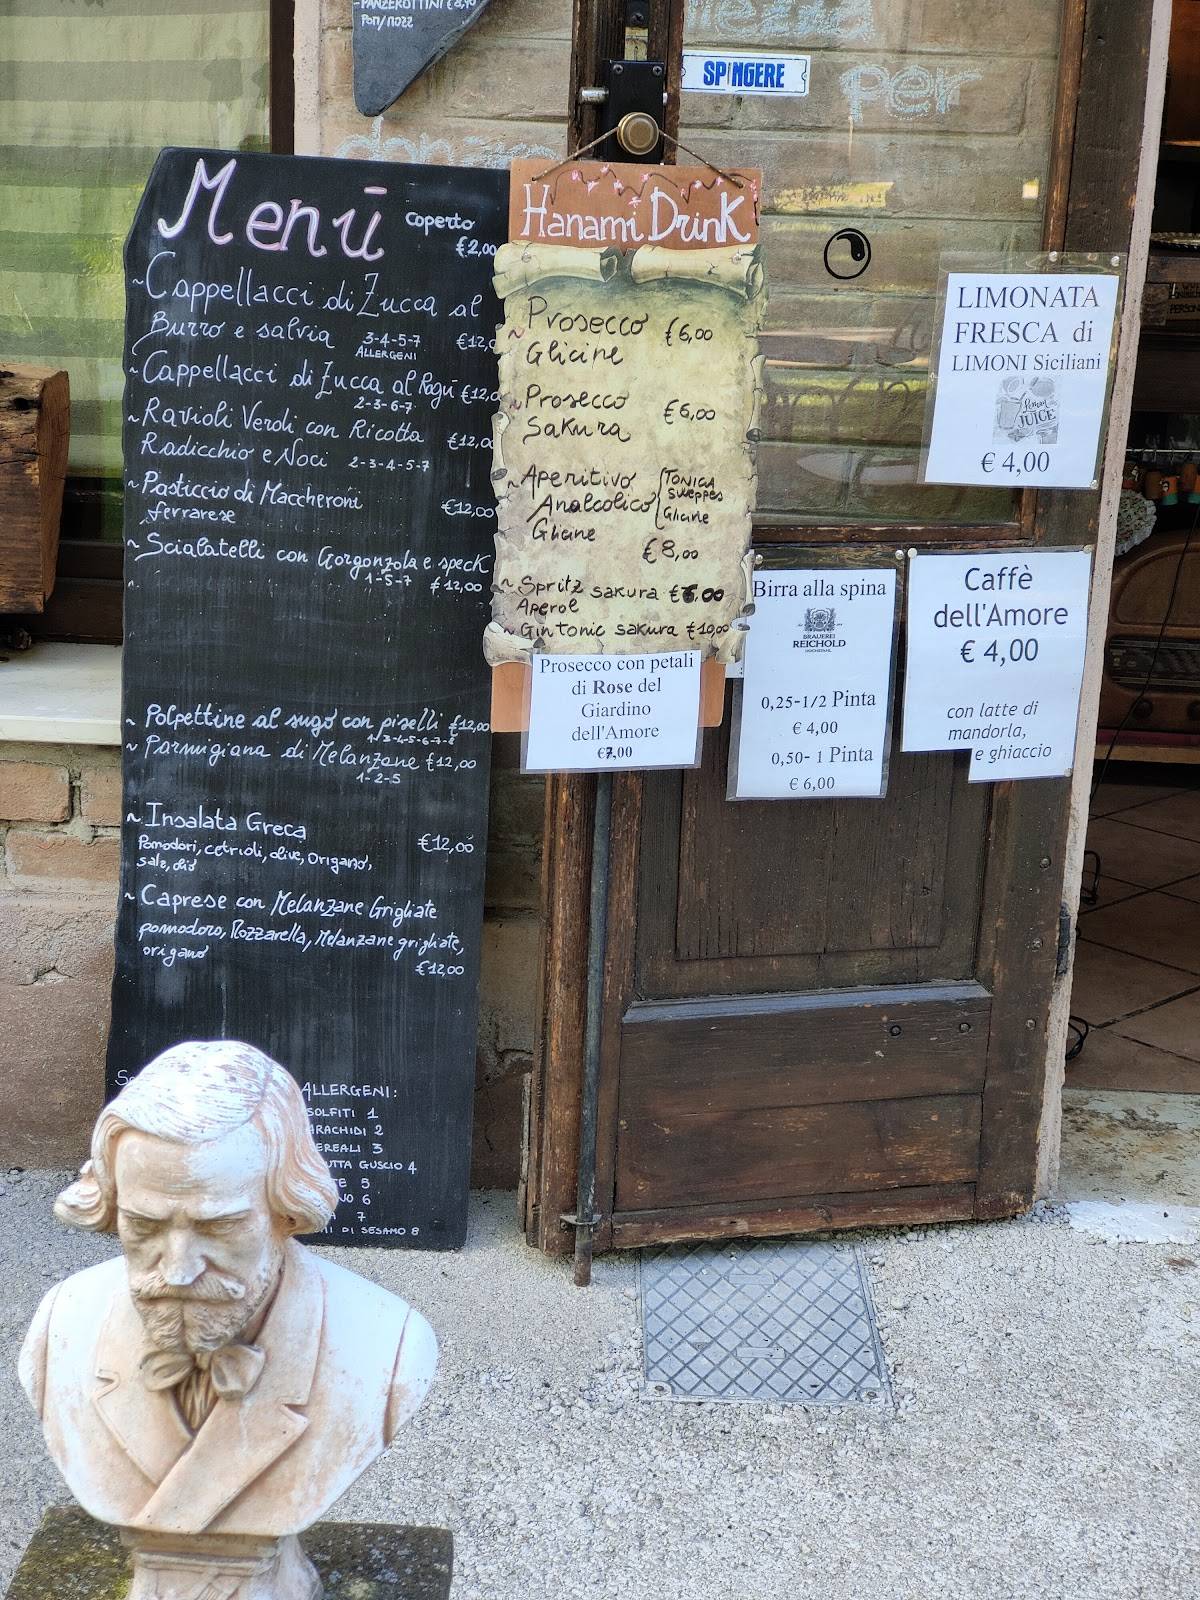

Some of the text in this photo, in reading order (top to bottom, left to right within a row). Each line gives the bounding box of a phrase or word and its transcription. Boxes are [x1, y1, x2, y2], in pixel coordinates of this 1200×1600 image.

[703, 60, 785, 88] SPINGERE
[520, 182, 644, 243] Hanami
[146, 250, 482, 318] Cappellacci di Zucca al
[956, 285, 1100, 309] LIMONATA
[528, 296, 649, 336] Prosecco
[132, 310, 336, 356] Burro e salvia
[953, 320, 1093, 344] FRESCA di
[526, 342, 624, 369] Glicine
[952, 352, 1102, 372] LIMONI Siciliani
[142, 350, 417, 400] Cappellacci di Zucca al
[525, 383, 630, 410] Prosecco
[142, 397, 425, 445] Ravioli Verdi con Ricotta
[1018, 408, 1057, 428] JUICE
[141, 431, 255, 461] Radicchio
[263, 449, 272, 463] e
[274, 437, 328, 467] Noci
[981, 451, 1050, 477] € 4,00
[142, 470, 230, 499] Pasticcio
[234, 481, 255, 504] di
[259, 479, 364, 511] Maccheroni
[521, 464, 637, 500] Aperitivo
[527, 491, 657, 522] Analcolico
[135, 532, 266, 562] Scialatelli
[276, 548, 309, 565] con
[317, 545, 418, 581] Gorgonzola
[423, 555, 431, 570] e
[518, 575, 584, 597] Spritz
[964, 565, 1033, 591] Caffè
[754, 579, 887, 601] Birra alla spina
[934, 603, 1069, 628] dell'Amore
[793, 640, 846, 648] REICHOLD
[960, 638, 1039, 667] € 4,00
[540, 652, 694, 674] Prosecco con petali
[571, 677, 662, 696] di Rose del
[581, 701, 651, 718] Giardino
[832, 690, 876, 707] Pinta
[947, 700, 1039, 719] con latte di
[145, 703, 245, 731] Polpettine
[252, 706, 283, 730] al
[285, 707, 338, 738] sugo
[342, 714, 374, 730] con
[375, 707, 444, 741] piselli
[571, 725, 660, 741] dell'Amore
[793, 721, 838, 736] € 4,00
[948, 723, 1027, 741] mandorla,
[145, 734, 272, 766] Parmigiana
[281, 741, 305, 760] di
[829, 745, 874, 763] Pinta
[975, 743, 1052, 764] e ghiaccio
[789, 776, 835, 791] € 6,00
[145, 802, 237, 831] Insalata
[246, 812, 307, 841] Greca
[141, 883, 438, 928] Caprese con Melanzane Grigliate
[306, 1107, 379, 1119] SOLFITI 1
[374, 1124, 384, 1136] 2
[316, 1143, 384, 1154] EREALI 3
[359, 1160, 417, 1175] GUSCIO 4
[361, 1178, 370, 1188] 5
[362, 1194, 371, 1205] 6
[357, 1212, 366, 1222] 7
[361, 1226, 406, 1235] SESAMO
[411, 1227, 419, 1235] 8
